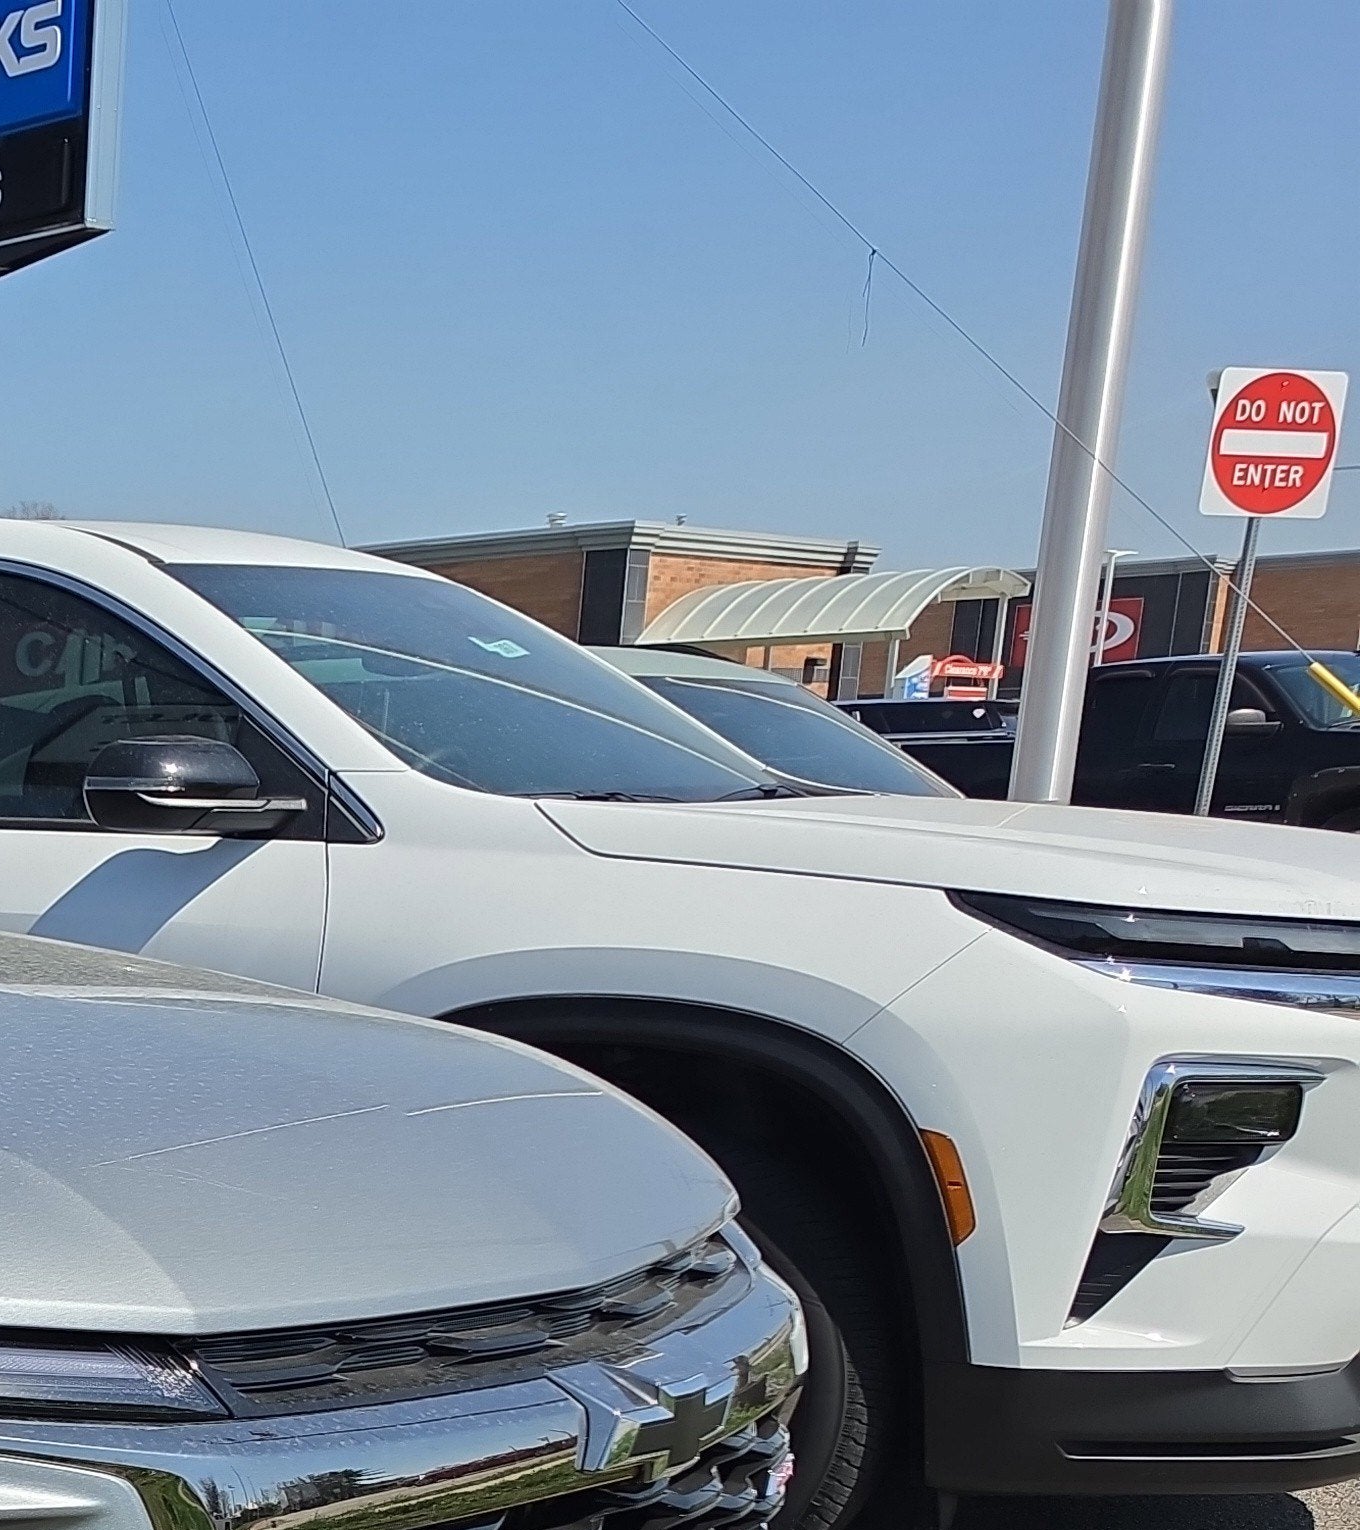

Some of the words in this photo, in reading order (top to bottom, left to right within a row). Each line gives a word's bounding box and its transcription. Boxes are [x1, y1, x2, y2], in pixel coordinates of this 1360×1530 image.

[1235, 399, 1266, 422] DO
[1278, 400, 1326, 424] NOT
[1232, 463, 1304, 488] ENTER
